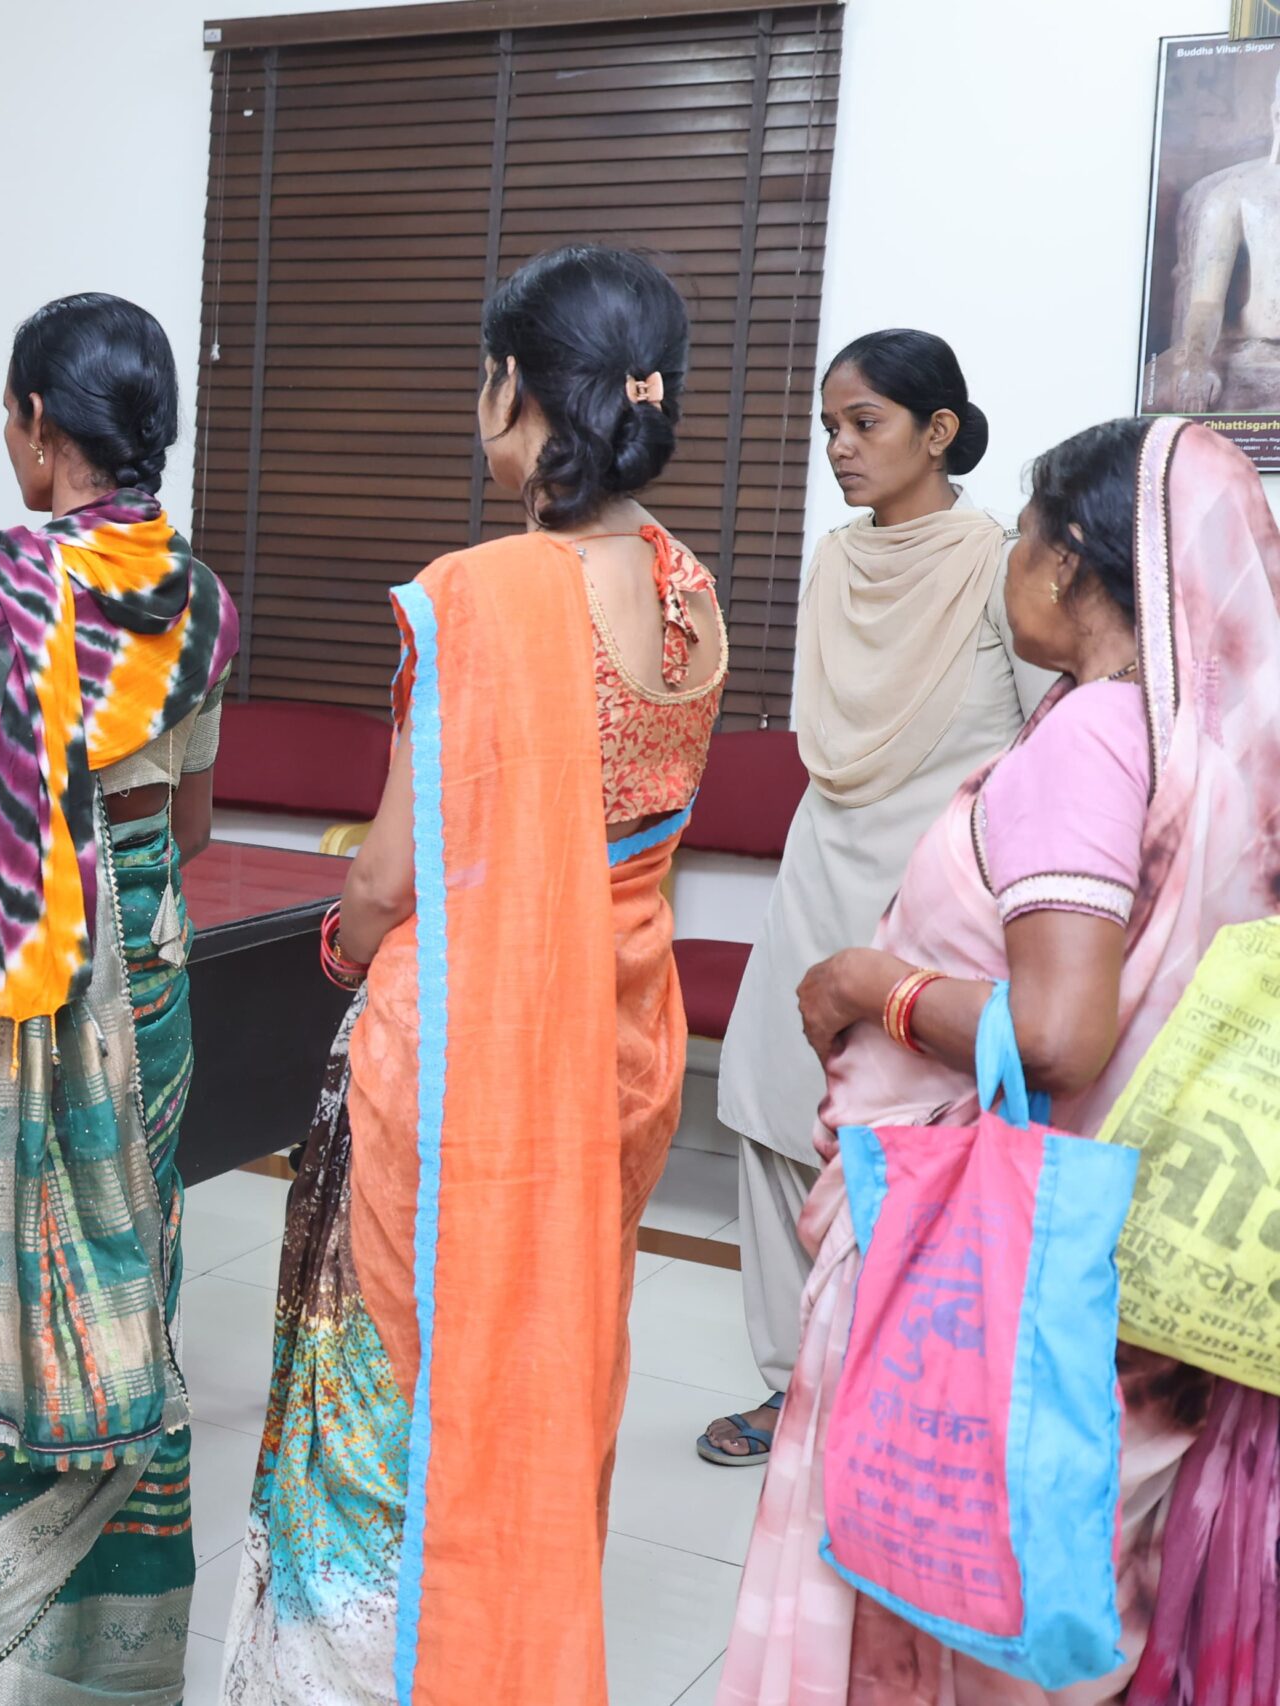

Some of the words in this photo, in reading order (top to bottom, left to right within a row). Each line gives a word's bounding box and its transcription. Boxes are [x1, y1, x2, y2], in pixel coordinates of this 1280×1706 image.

[1176, 47, 1213, 58] Buddha
[1216, 44, 1242, 54] Vihar,
[1245, 42, 1275, 53] Sirpur
[1203, 420, 1280, 432] Chhattisgarh
